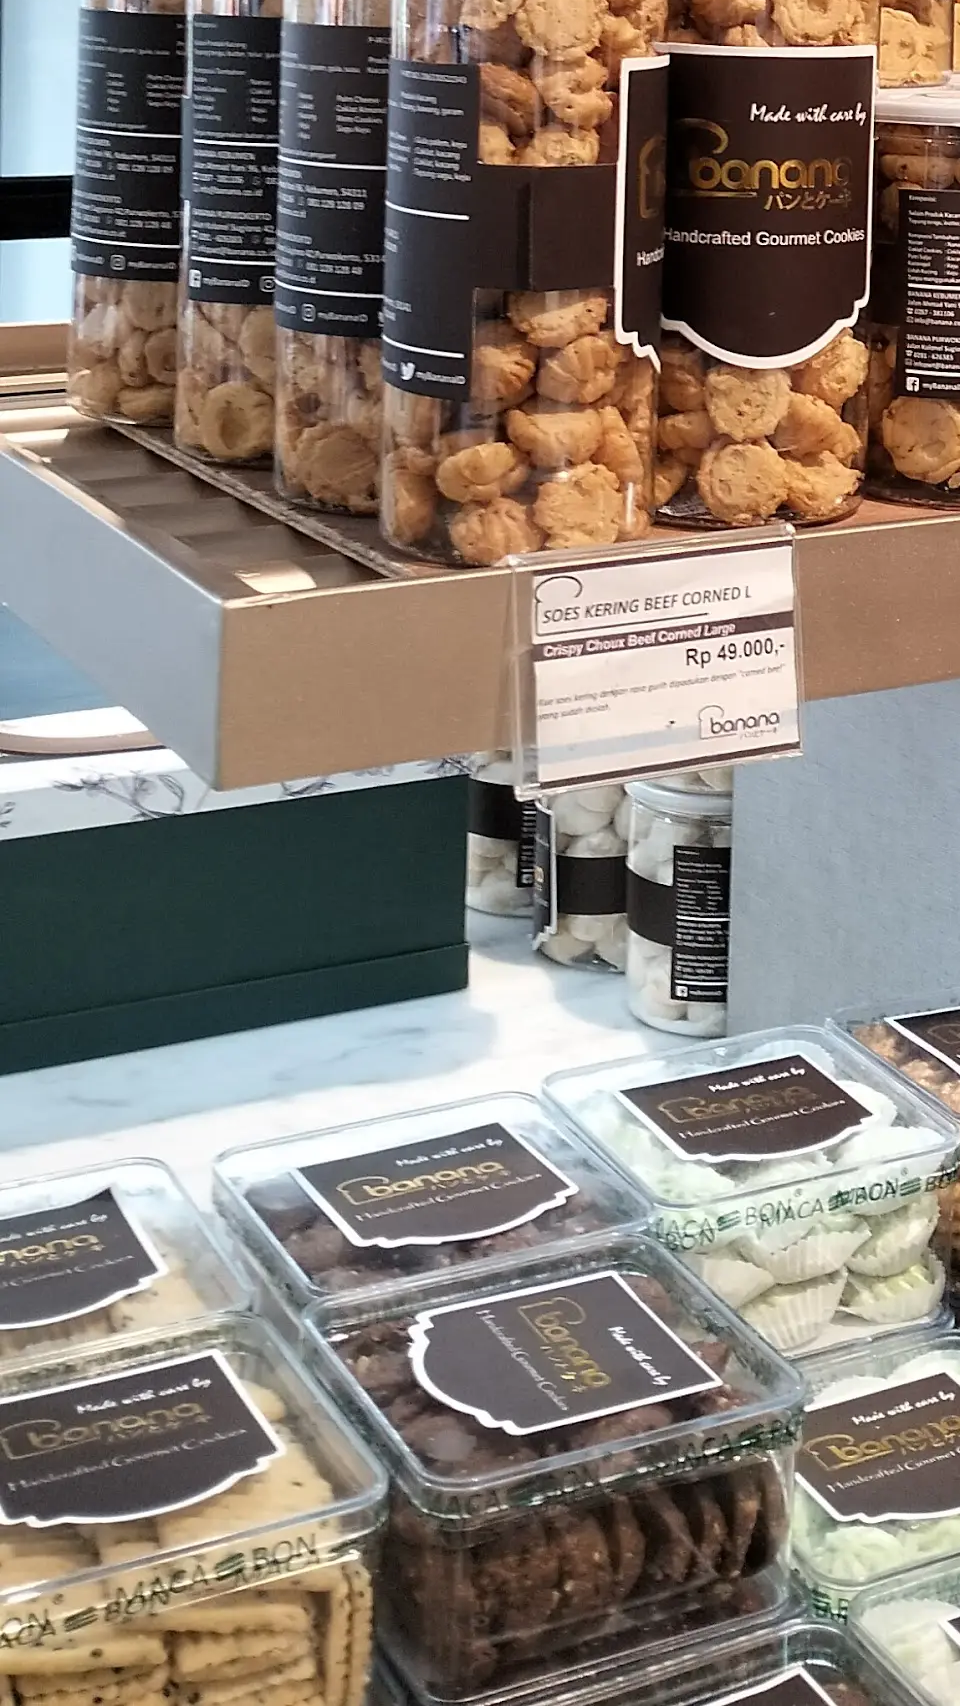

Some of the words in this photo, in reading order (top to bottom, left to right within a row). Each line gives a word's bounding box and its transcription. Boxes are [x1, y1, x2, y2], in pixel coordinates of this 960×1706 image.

[750, 103, 792, 123] Made
[795, 103, 828, 124] with
[690, 156, 852, 190] banana
[663, 227, 751, 246] Handcrafted
[755, 230, 822, 247] Gourmet
[823, 227, 865, 244] Cookies
[542, 606, 580, 624] SOES
[584, 598, 639, 619] KERING
[644, 594, 678, 612] BEEF
[682, 586, 741, 606] CORNED
[744, 585, 752, 599] L
[543, 642, 584, 658] Crispy
[586, 638, 625, 654] Choux
[627, 633, 656, 647] Beef
[657, 627, 702, 643] Corned
[703, 622, 736, 638] Large
[685, 648, 711, 669] Rp
[716, 637, 786, 660] 49.000,-
[711, 711, 780, 734] banana
[363, 1160, 505, 1198] banana
[27, 1402, 204, 1448] banana
[826, 1463, 903, 1494] Handcrafted
[904, 1450, 955, 1472] Gourmet
